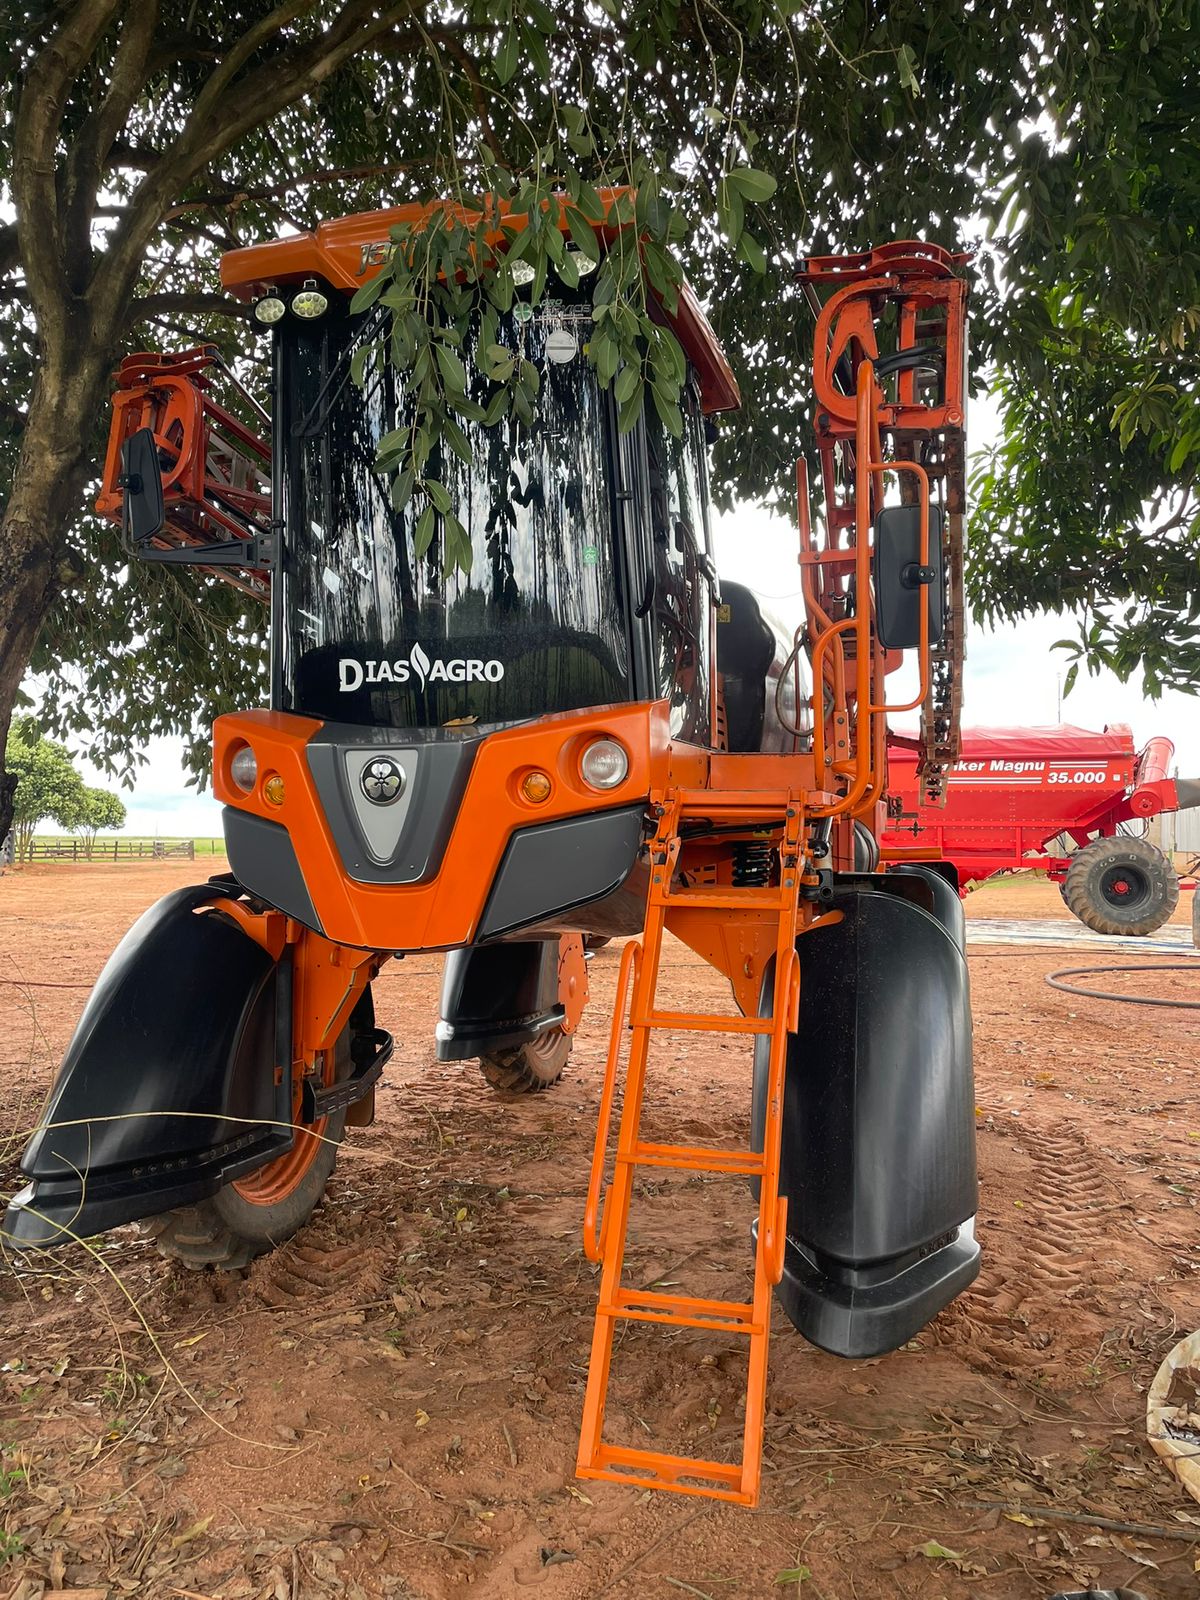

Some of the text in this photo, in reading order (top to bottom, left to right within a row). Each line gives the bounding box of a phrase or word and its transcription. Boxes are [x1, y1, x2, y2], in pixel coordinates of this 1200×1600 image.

[338, 658, 505, 692] DIAS AGRO
[989, 760, 1046, 773] Magnu
[1047, 771, 1106, 784] 35.000
